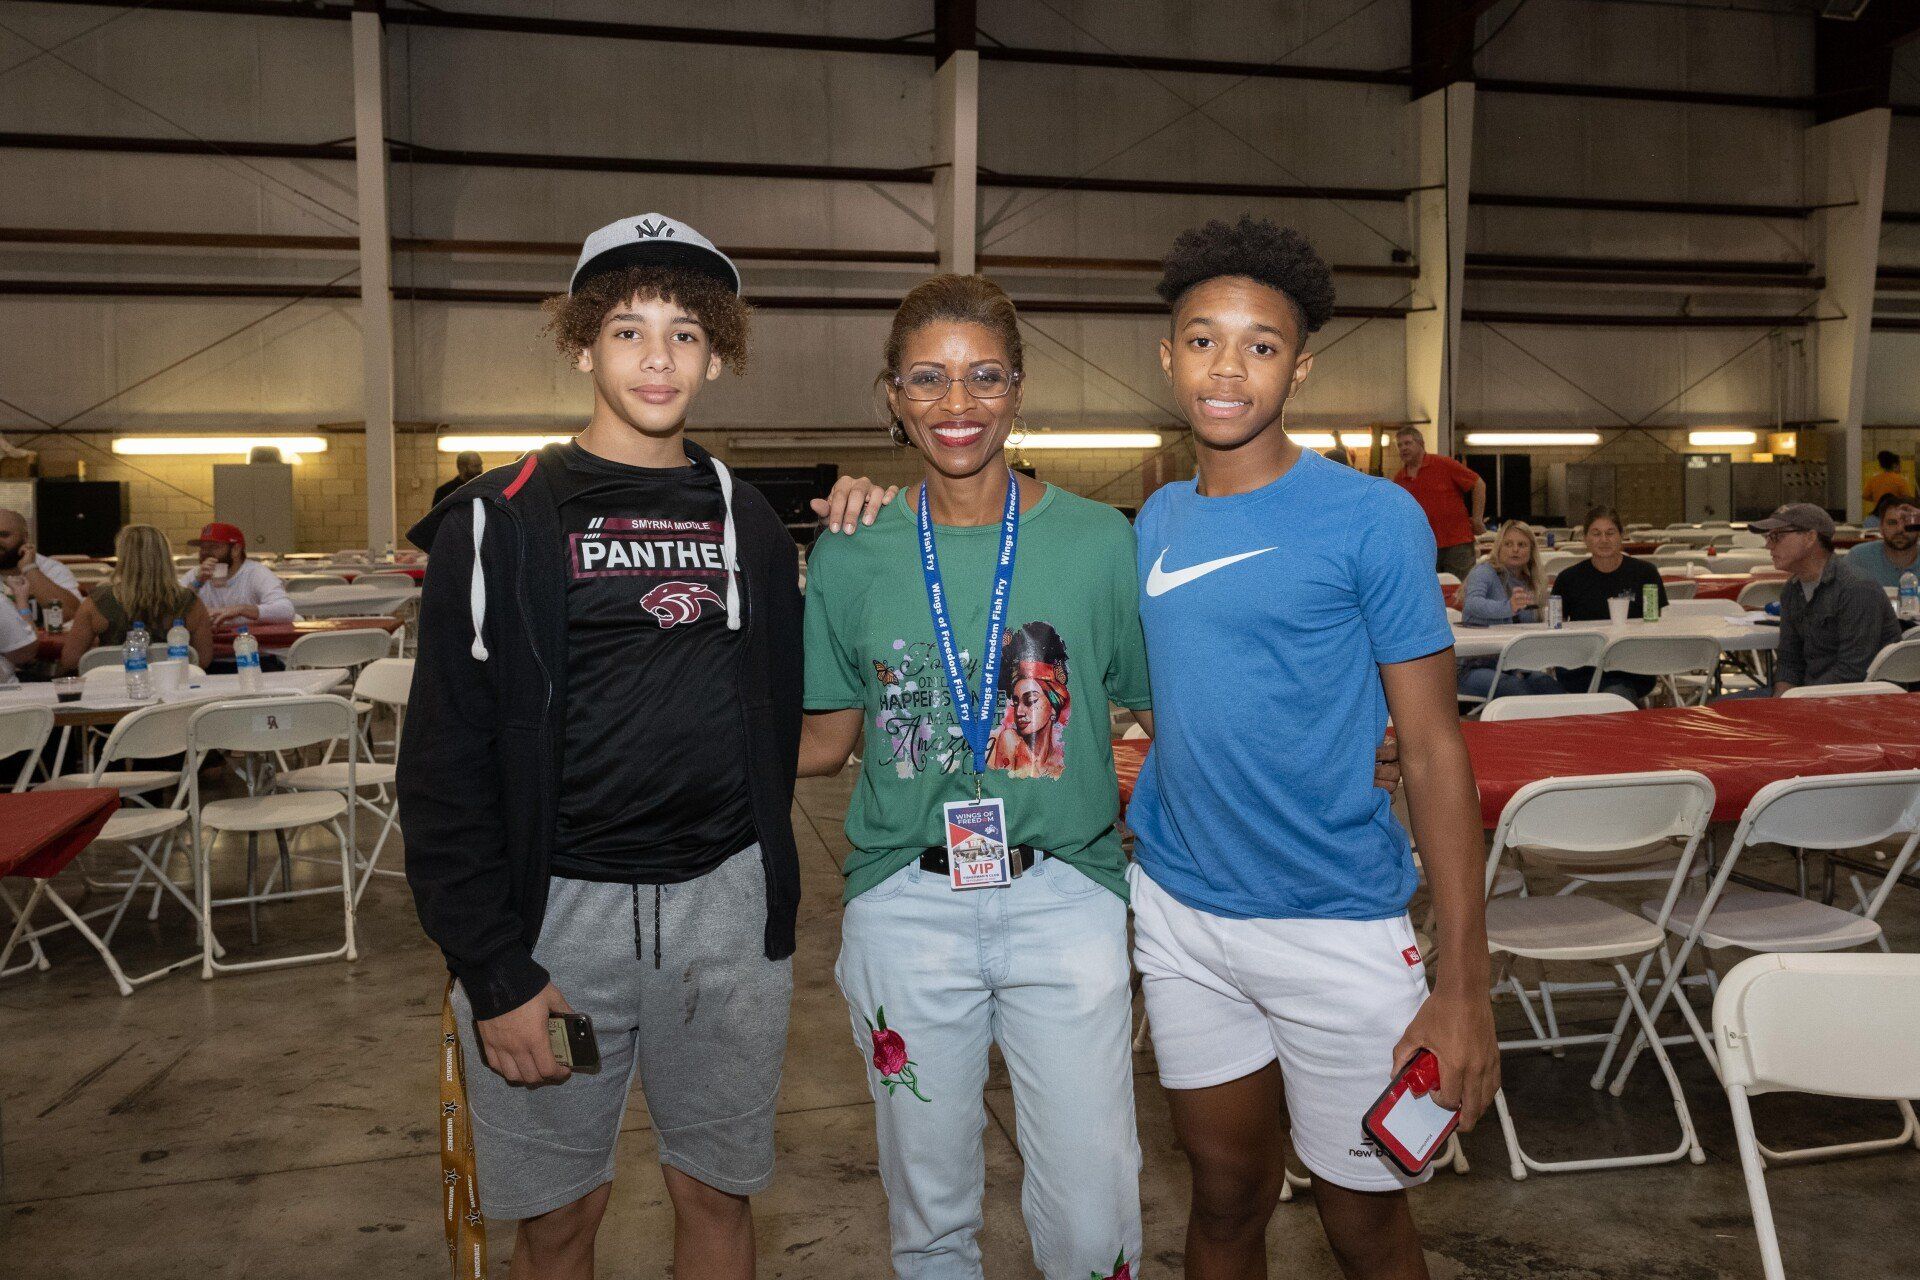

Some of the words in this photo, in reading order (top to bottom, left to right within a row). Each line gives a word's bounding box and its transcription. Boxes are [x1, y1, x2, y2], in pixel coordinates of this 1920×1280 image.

[1006, 482, 1016, 521] Freedom
[631, 519, 673, 529] SMYRNA
[674, 521, 711, 530] MIDDLE
[1006, 521, 1014, 532] of
[924, 531, 932, 552] Fish
[1001, 535, 1013, 565] Wings
[927, 554, 935, 571] Fry
[996, 578, 1007, 595] Fry
[931, 582, 942, 615] Wings
[992, 597, 1002, 621] Fish
[938, 616, 945, 627] of
[941, 630, 957, 677] Freedom
[986, 622, 1000, 670] Freedom
[986, 672, 994, 684] of
[880, 690, 951, 710] HAPPENS
[953, 678, 965, 702] Fish
[961, 703, 970, 721] Fry
[981, 692, 993, 720] Wings
[968, 863, 994, 874] VIP
[1349, 1148, 1373, 1157] new
